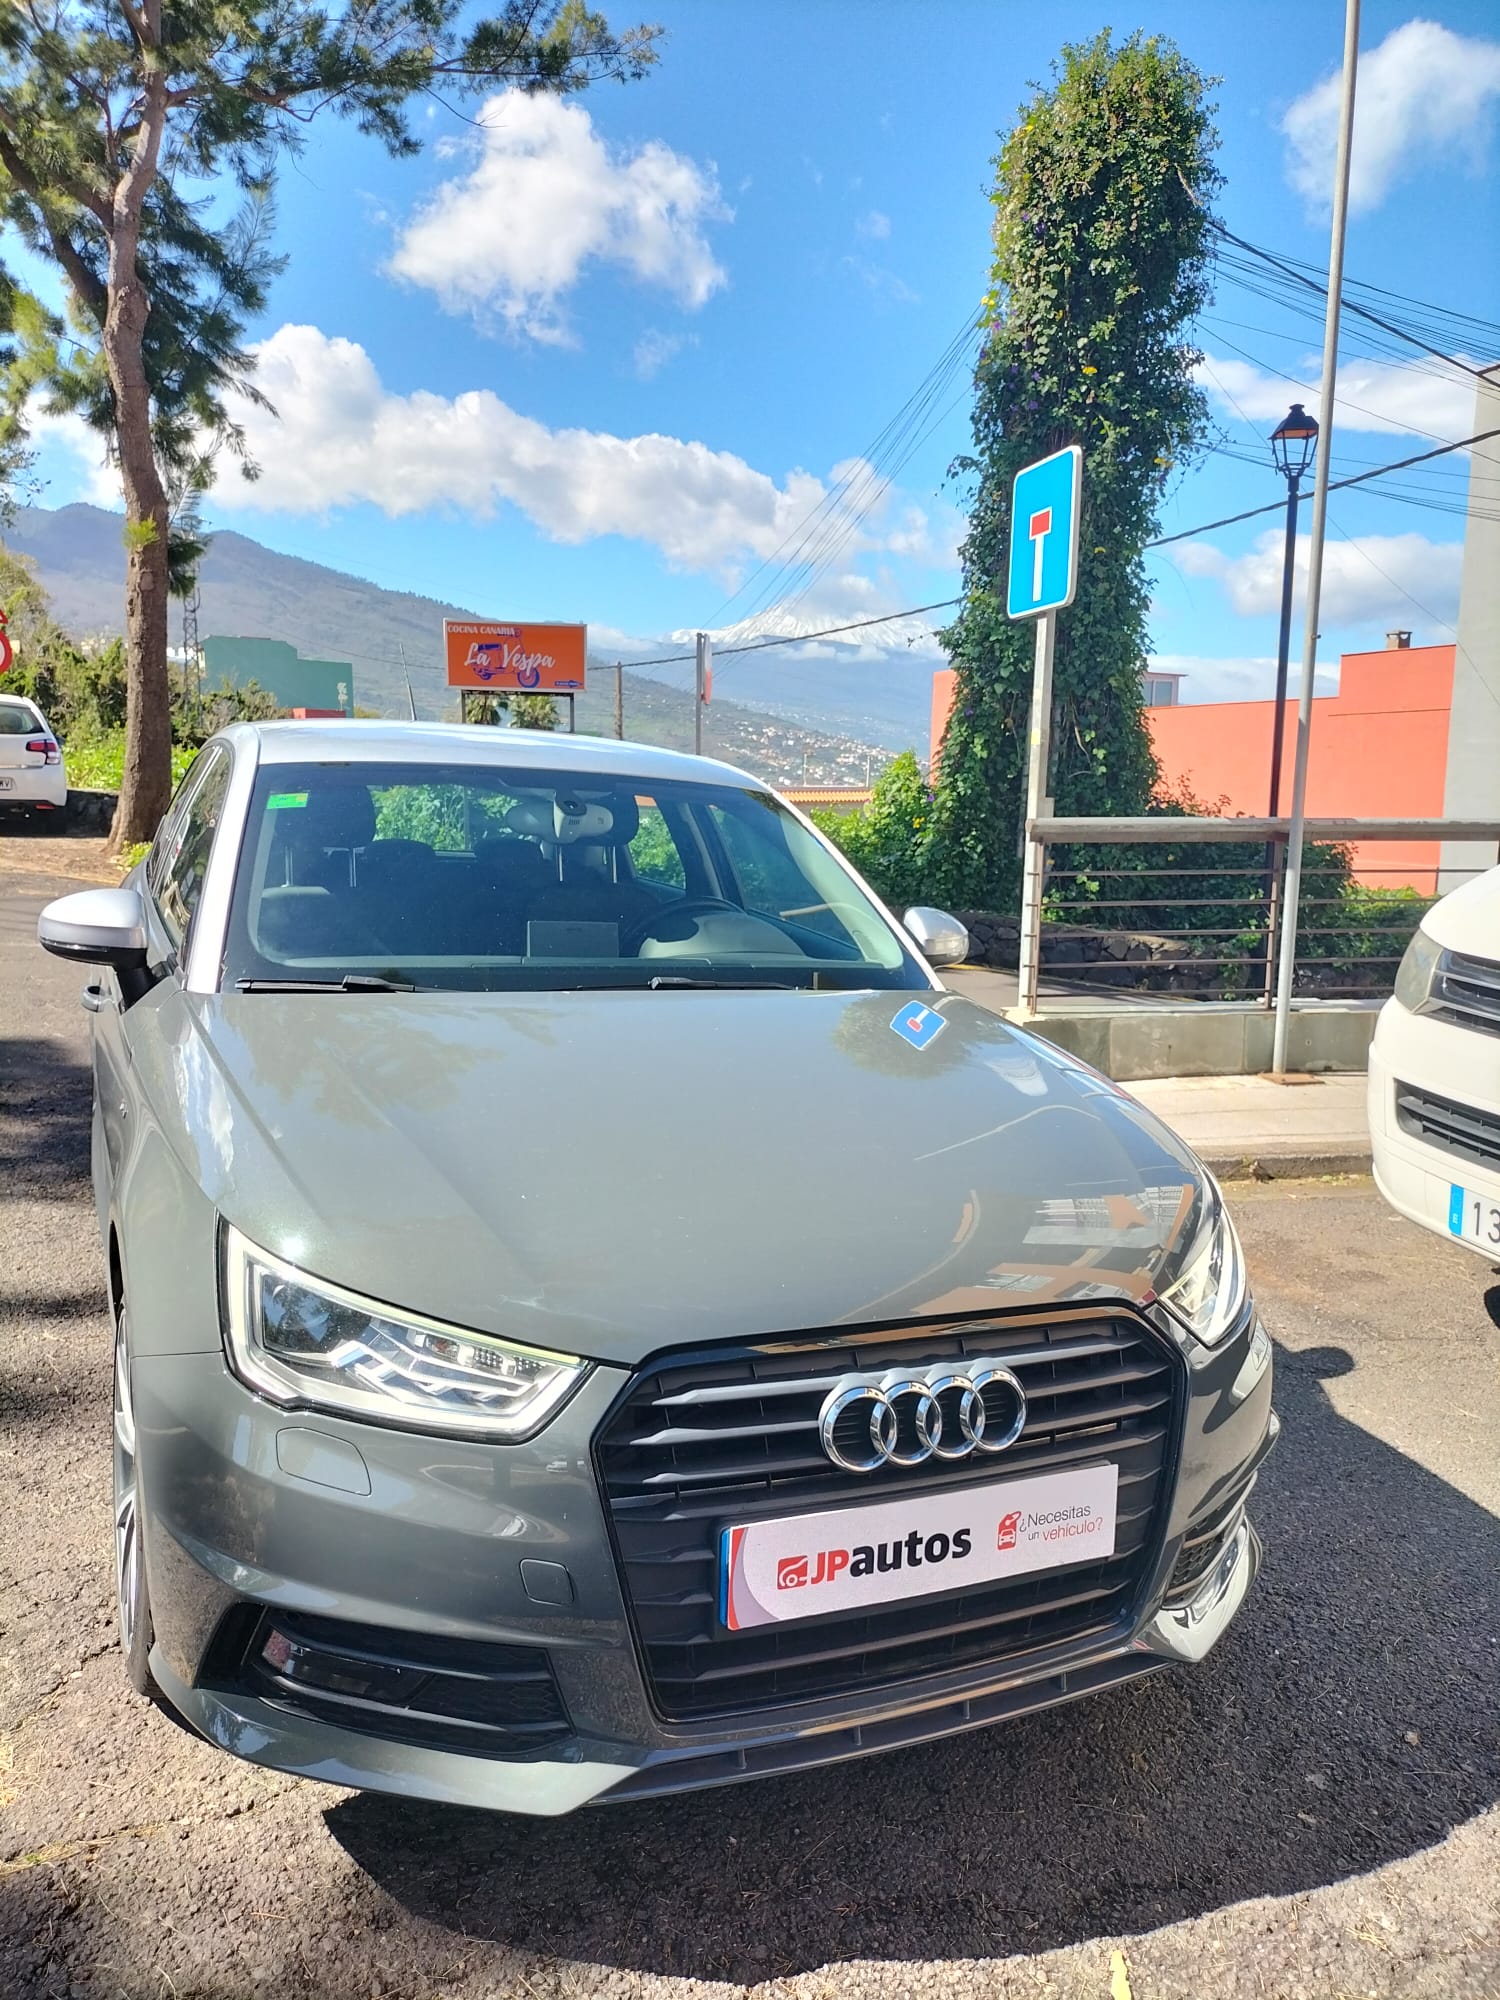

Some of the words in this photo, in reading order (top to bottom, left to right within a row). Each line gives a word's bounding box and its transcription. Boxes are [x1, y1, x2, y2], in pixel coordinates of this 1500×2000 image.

[448, 625, 477, 634] COCINA
[480, 626, 515, 636] CANARIA
[464, 642, 491, 666] La
[502, 643, 555, 676] Vespa
[1019, 1505, 1091, 1532] ¿Necesitas
[1028, 1531, 1040, 1540] un
[1042, 1516, 1103, 1541] vehículo?
[811, 1528, 972, 1585] JPautos
